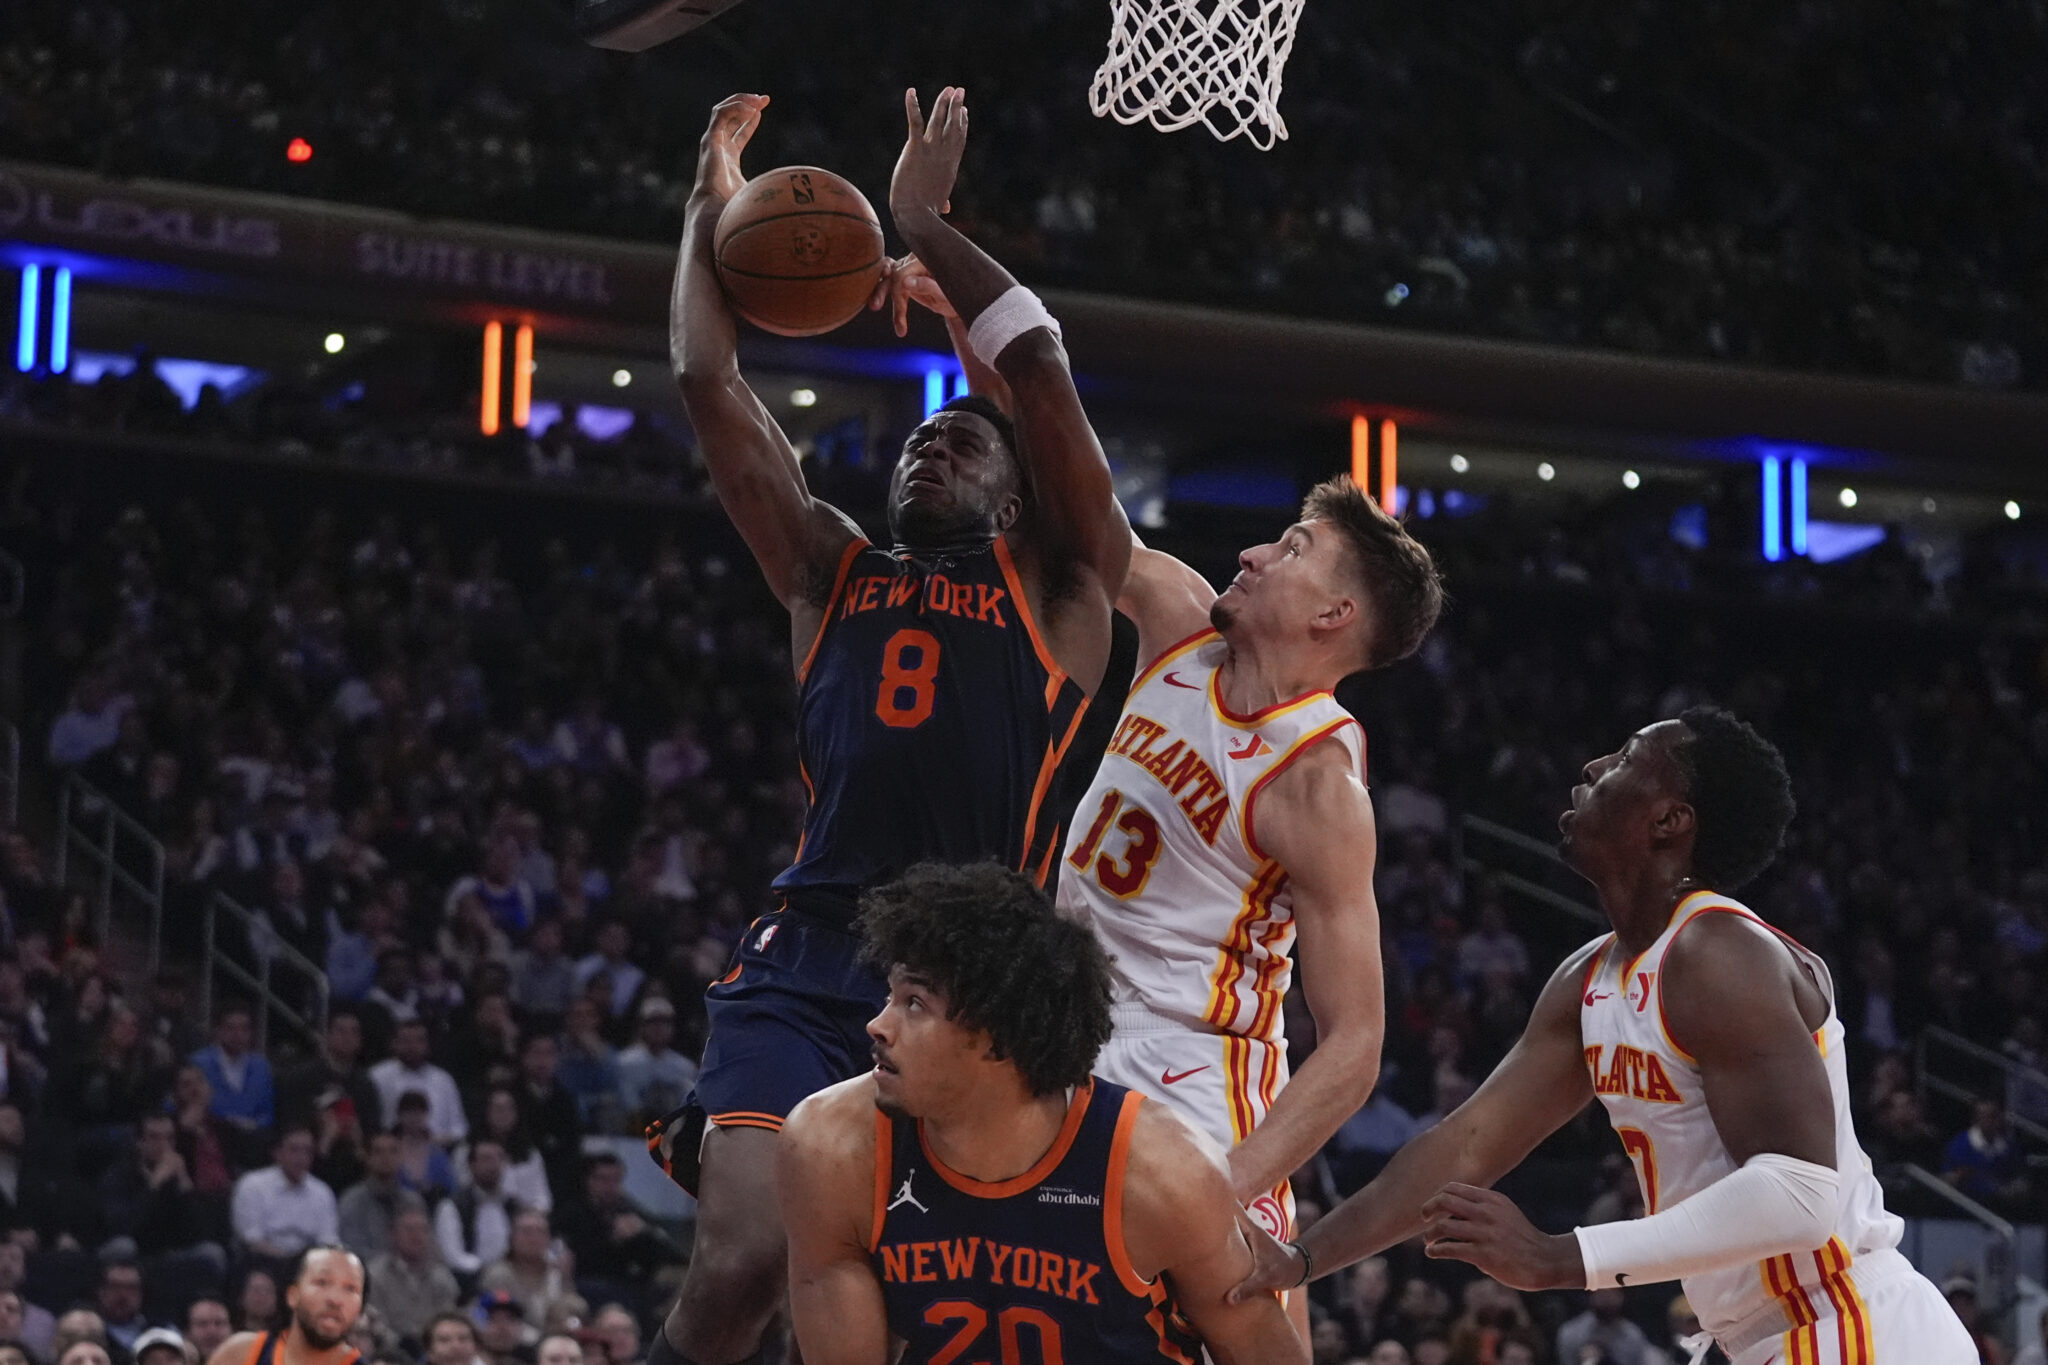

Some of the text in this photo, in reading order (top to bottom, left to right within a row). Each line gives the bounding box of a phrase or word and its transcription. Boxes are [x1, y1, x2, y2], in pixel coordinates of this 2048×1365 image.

[36, 195, 280, 256] LEXUS
[355, 232, 610, 304] SUITE LEVEL
[840, 574, 920, 622] NEW
[875, 628, 941, 728] 8
[1105, 712, 1229, 847] ATLANTA
[1068, 789, 1163, 902] 13
[1038, 1192, 1100, 1206] abu dhabi
[880, 1237, 1101, 1305] NEW YORK
[923, 1300, 1065, 1365] 20
